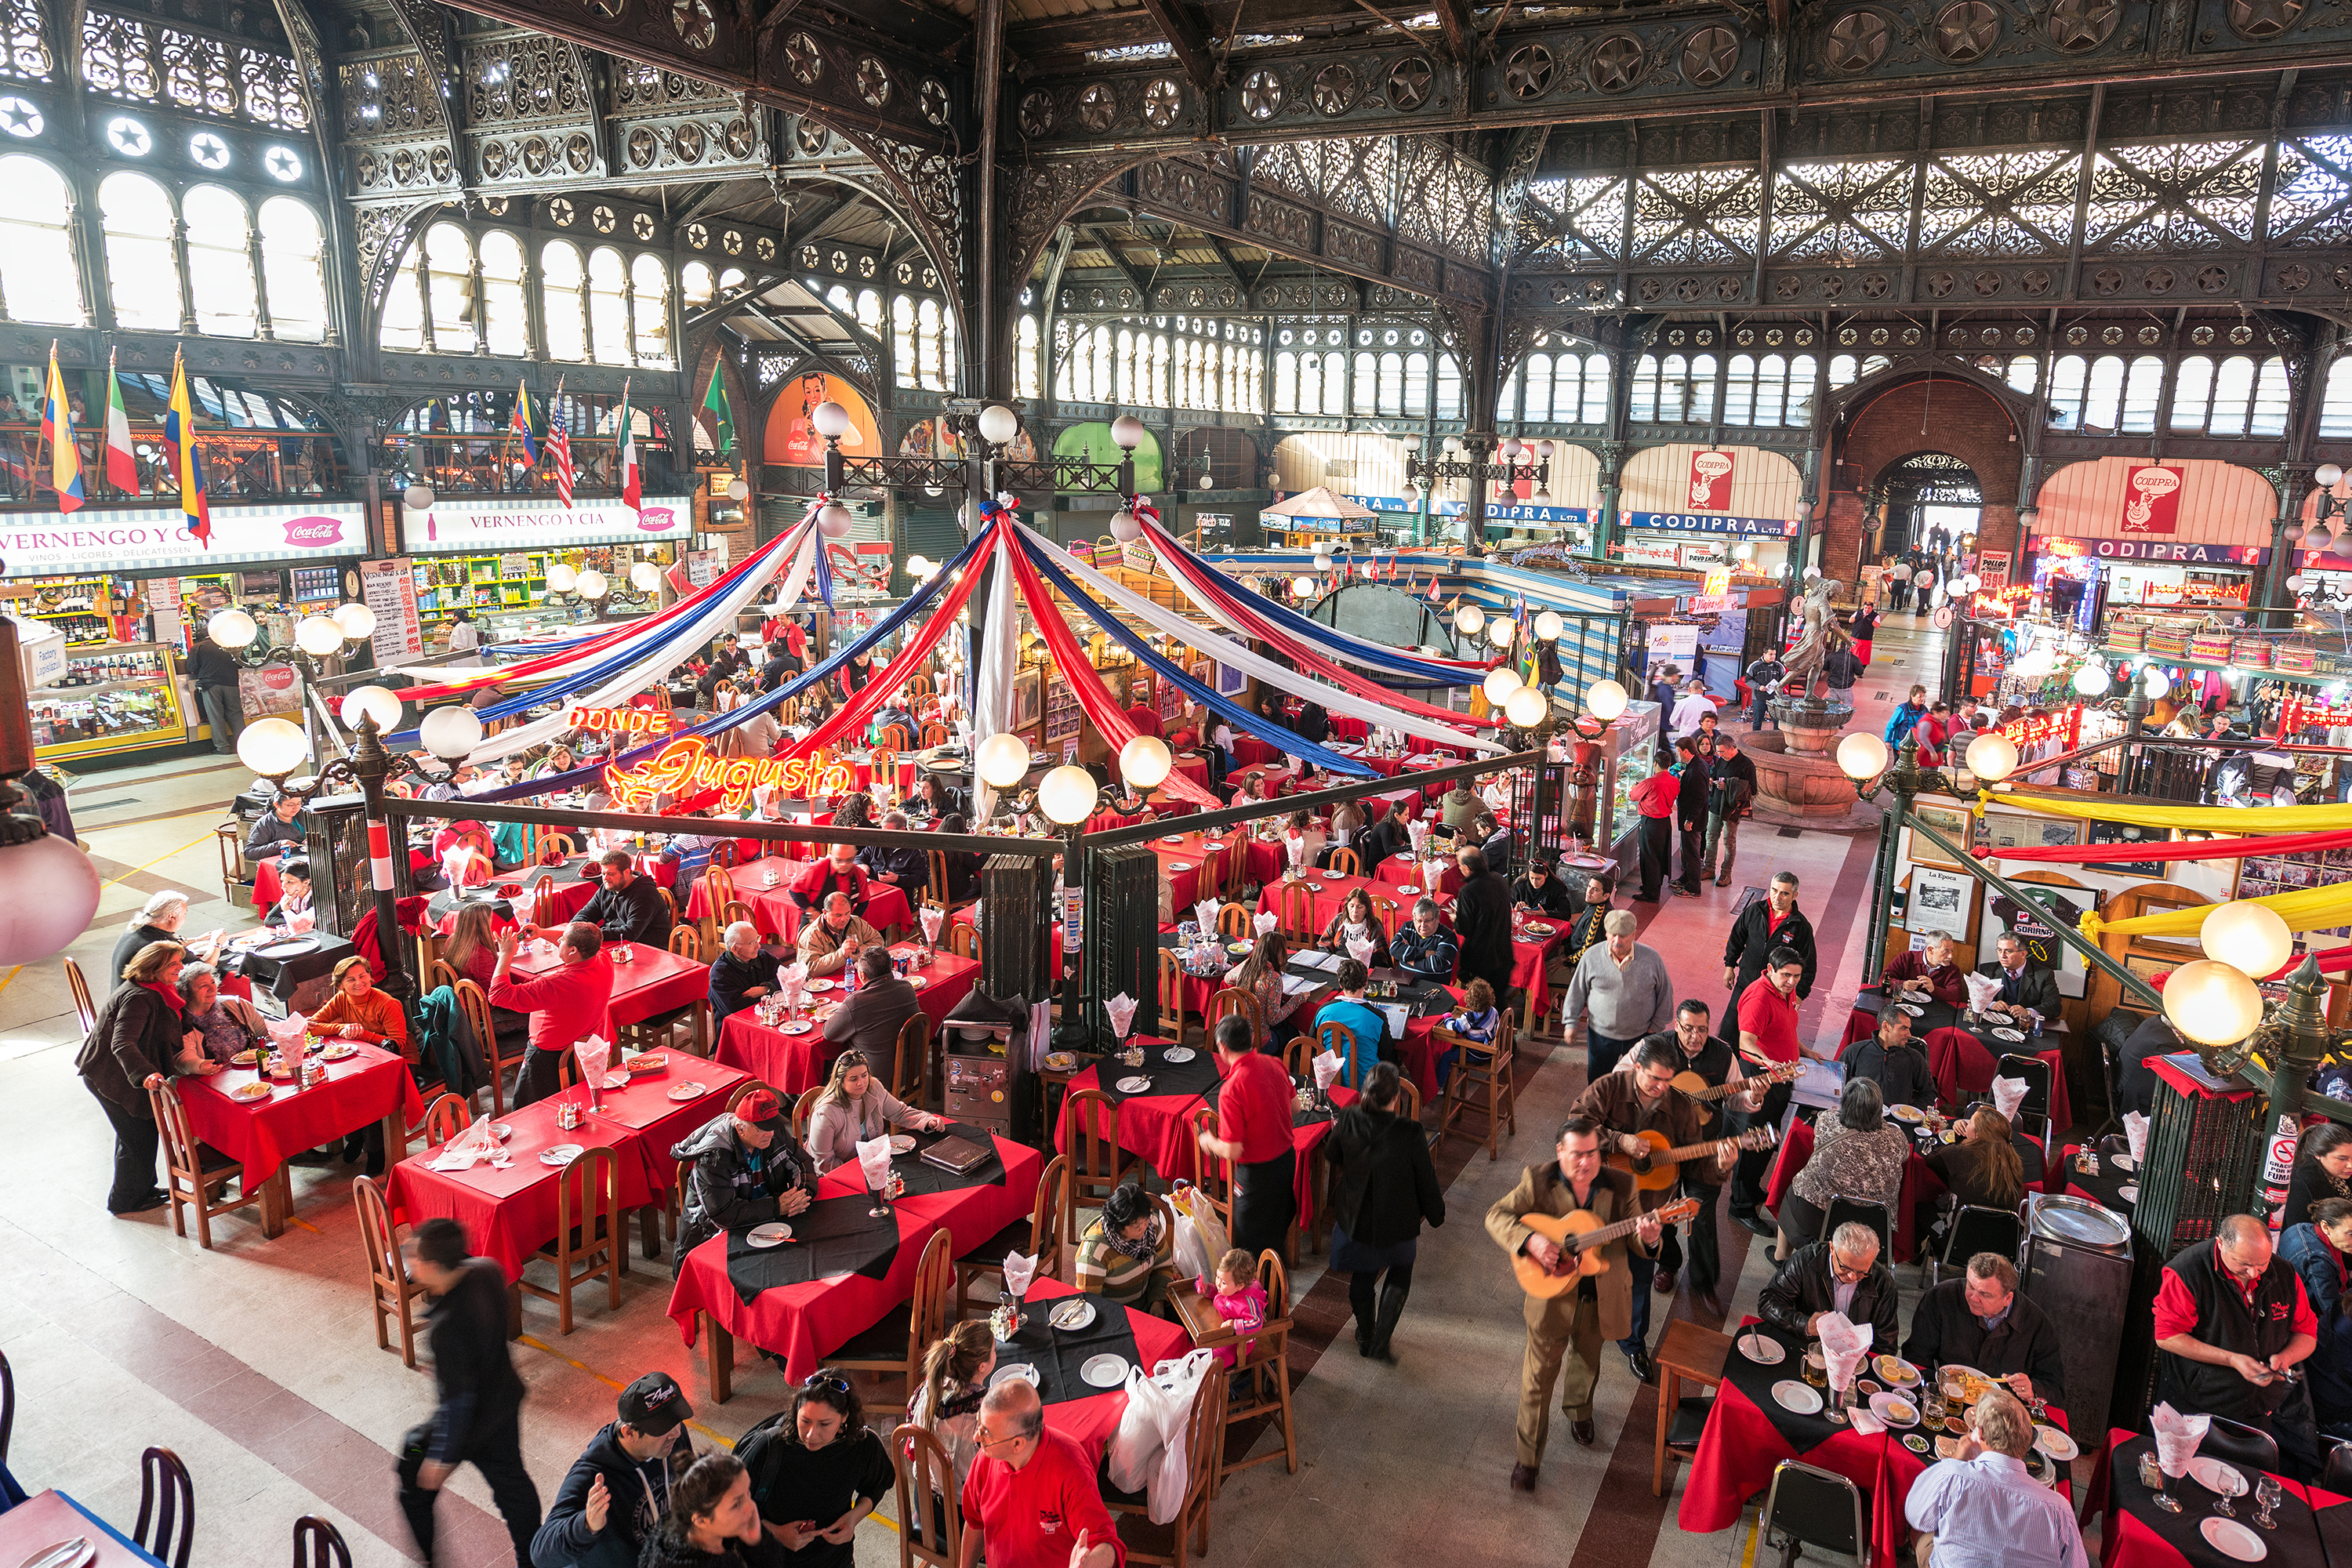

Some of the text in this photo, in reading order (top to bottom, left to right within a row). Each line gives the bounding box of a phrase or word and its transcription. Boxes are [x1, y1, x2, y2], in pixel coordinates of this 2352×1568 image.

[1501, 452, 1530, 461] COIPRA
[1697, 460, 1730, 470] CODIPRA
[2135, 476, 2177, 487] CODIPRA
[1456, 503, 1551, 520] CDIPRA
[470, 513, 604, 528] VERNENGO Y CIA
[1650, 514, 1757, 533] CODIPRA
[0, 526, 217, 550] VERNENGO Y CA
[291, 524, 334, 540] Coca-Cola
[71, 551, 112, 560] LICORES
[123, 547, 191, 557] DELICATESSEN
[1982, 559, 2007, 568] POLLOS
[1980, 572, 2005, 589] 1598
[39, 649, 56, 662] Factory
[265, 670, 292, 681] Coca-Cola
[566, 706, 672, 733] DONDE
[604, 735, 855, 814] Augusto
[2016, 925, 2053, 936] SORIANA
[2267, 1171, 2289, 1181] FUMA
